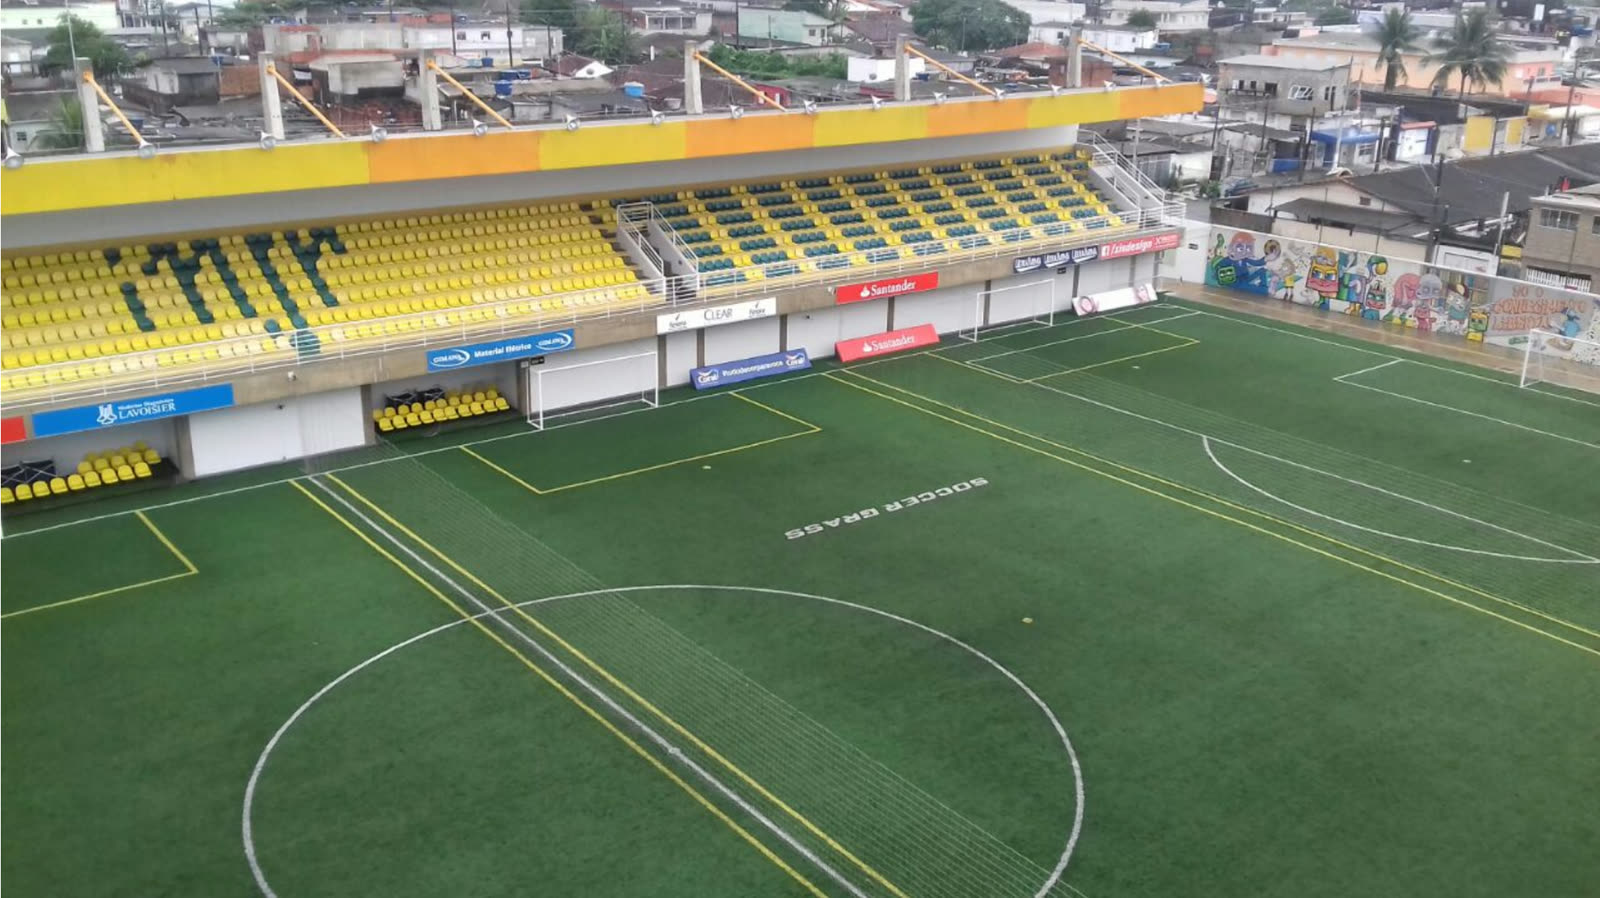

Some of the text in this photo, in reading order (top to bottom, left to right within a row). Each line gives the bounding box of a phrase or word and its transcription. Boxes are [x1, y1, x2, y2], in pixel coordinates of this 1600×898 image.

[871, 280, 916, 296] Santander
[704, 308, 733, 321] CLEAR
[871, 335, 915, 351] Santander
[474, 346, 504, 358] Material
[119, 402, 176, 419] LAVOISIER
[785, 477, 989, 540] SOCCER GRASS
